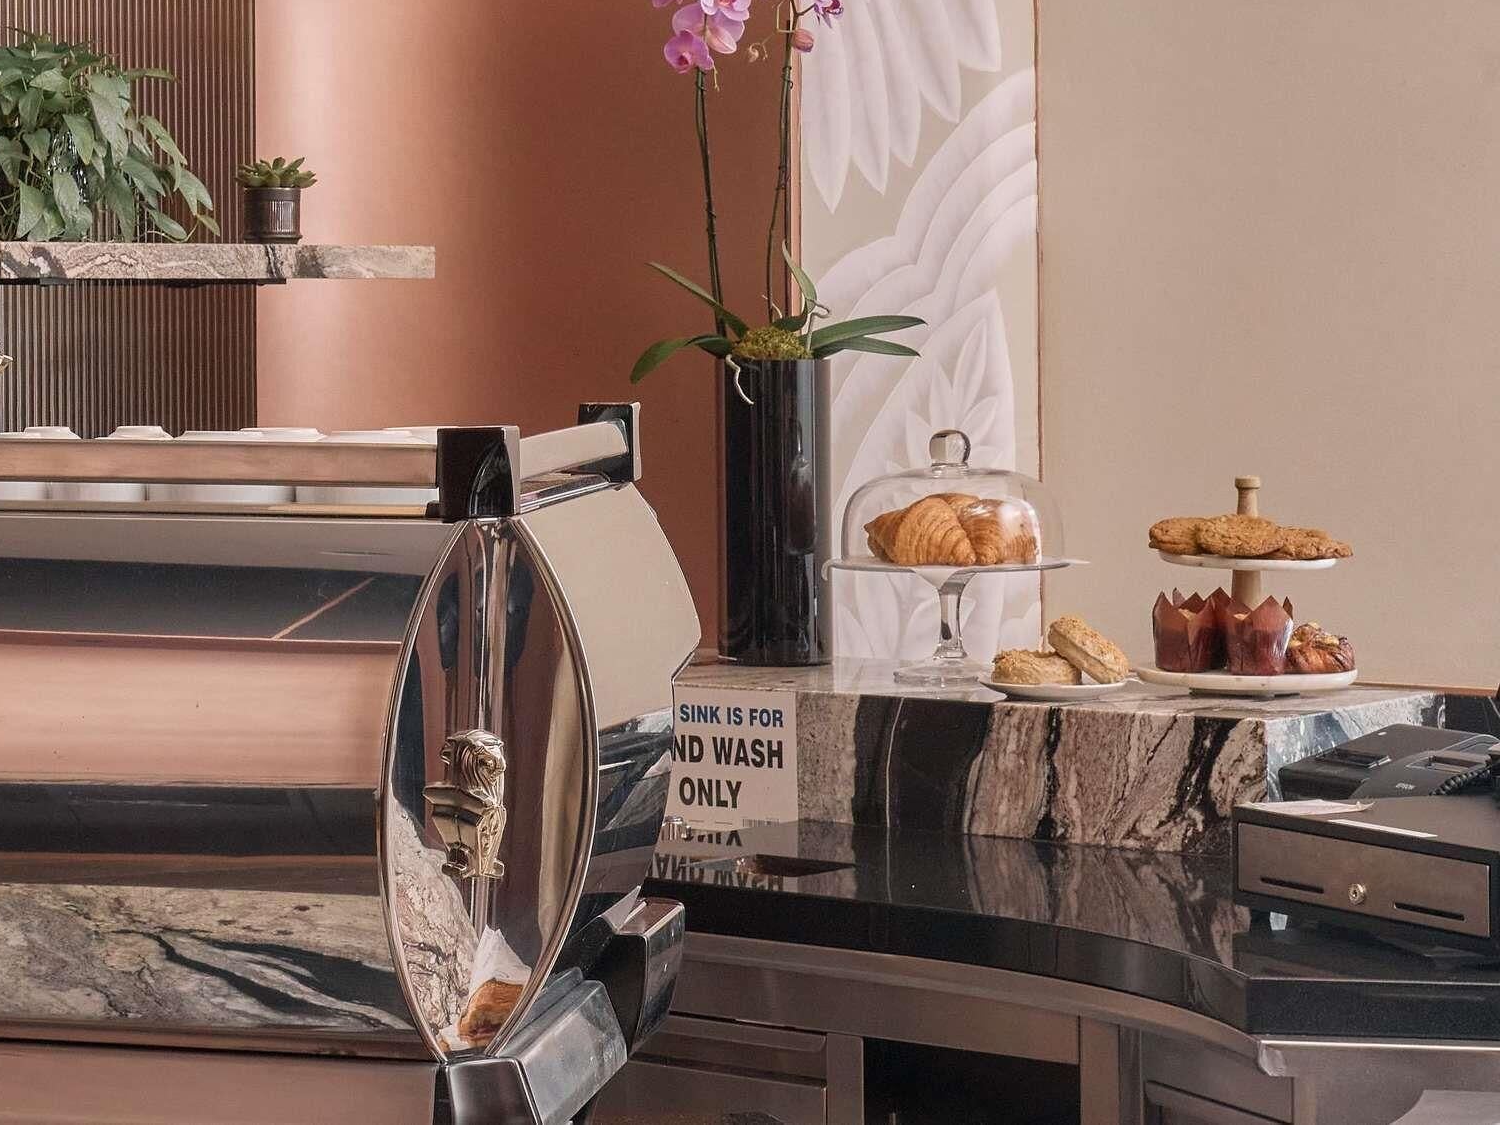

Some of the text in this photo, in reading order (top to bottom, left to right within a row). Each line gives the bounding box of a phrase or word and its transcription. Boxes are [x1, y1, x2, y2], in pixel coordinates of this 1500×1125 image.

[679, 703, 784, 728] SINK IS FOR
[672, 733, 784, 769] ND WASH
[678, 776, 742, 809] ONLY
